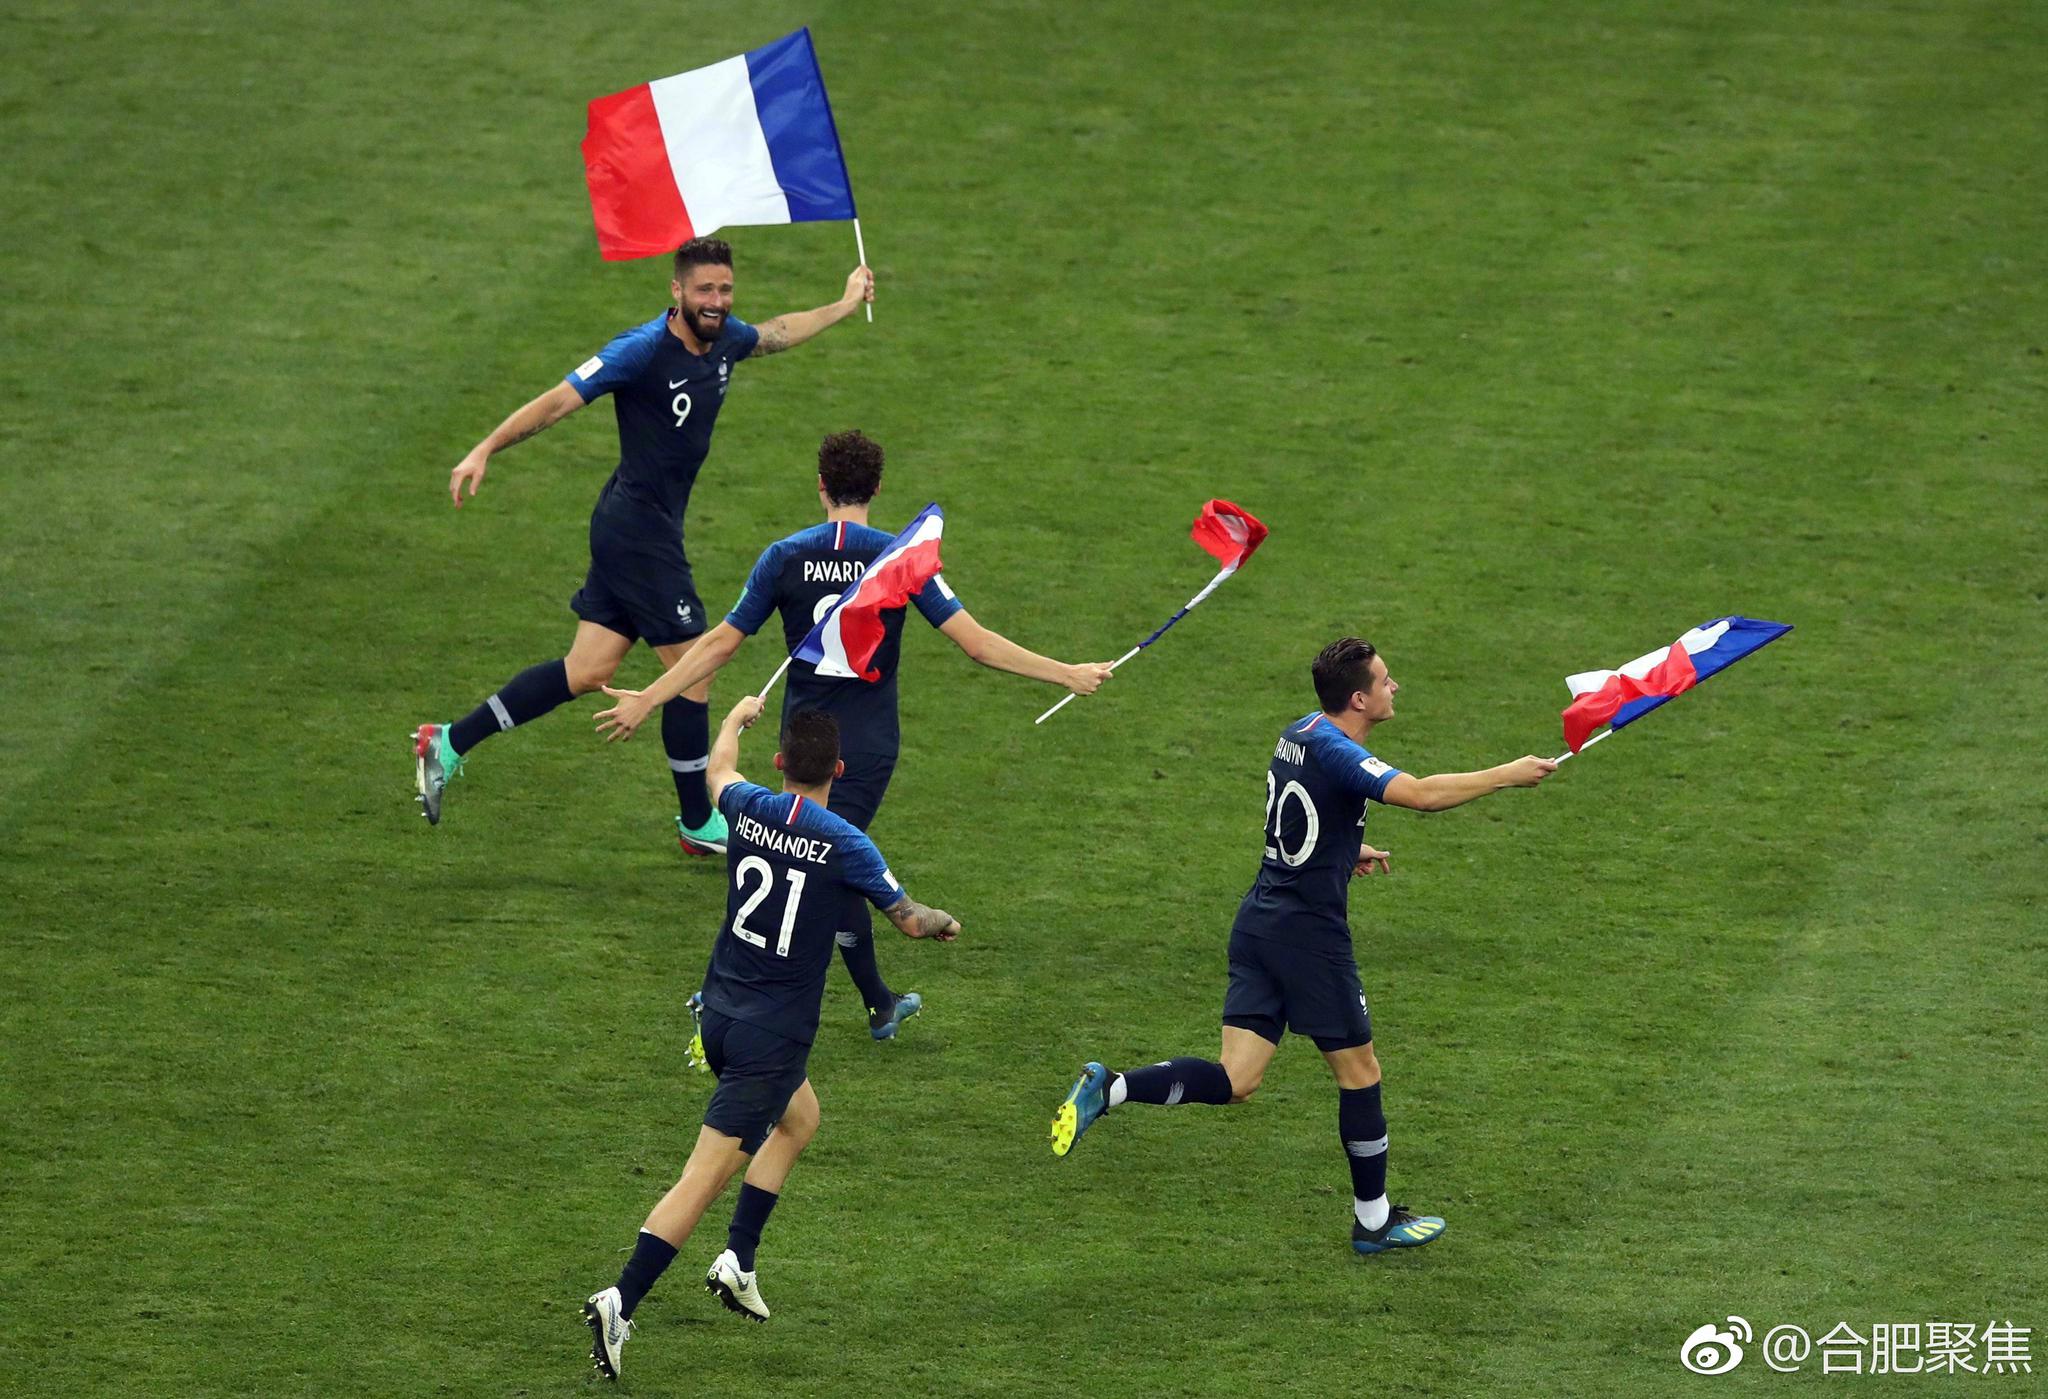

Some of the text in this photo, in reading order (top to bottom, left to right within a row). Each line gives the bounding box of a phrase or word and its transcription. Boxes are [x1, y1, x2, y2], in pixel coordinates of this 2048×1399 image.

[671, 392, 692, 428] 9
[803, 560, 865, 582] PAVARD
[735, 812, 833, 865] HERNANDEZ
[732, 855, 807, 958] 21
